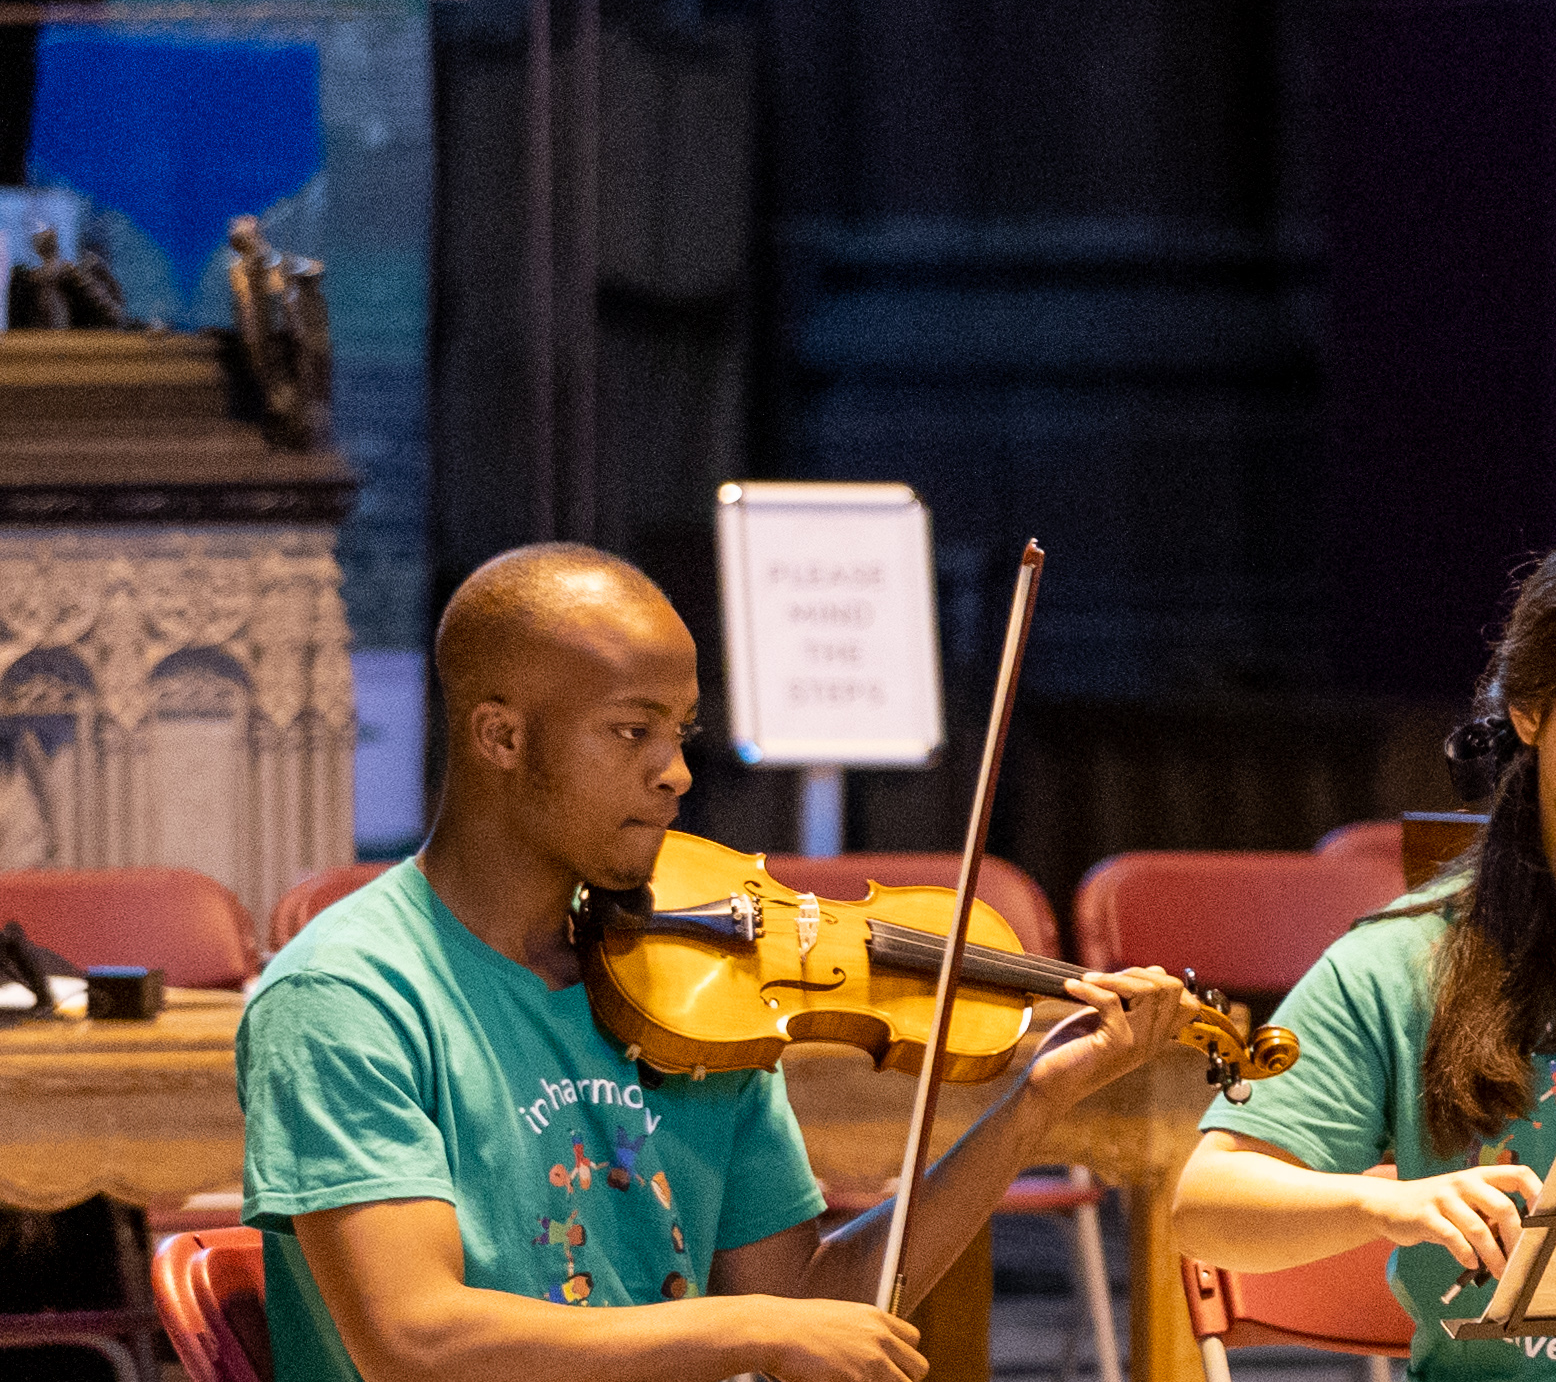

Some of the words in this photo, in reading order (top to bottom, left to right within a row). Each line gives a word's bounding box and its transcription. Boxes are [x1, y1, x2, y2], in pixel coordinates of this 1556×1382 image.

[768, 562, 884, 588] PLEASE
[788, 601, 873, 628] MIND
[804, 640, 861, 665] THE
[788, 680, 885, 707] STEPS
